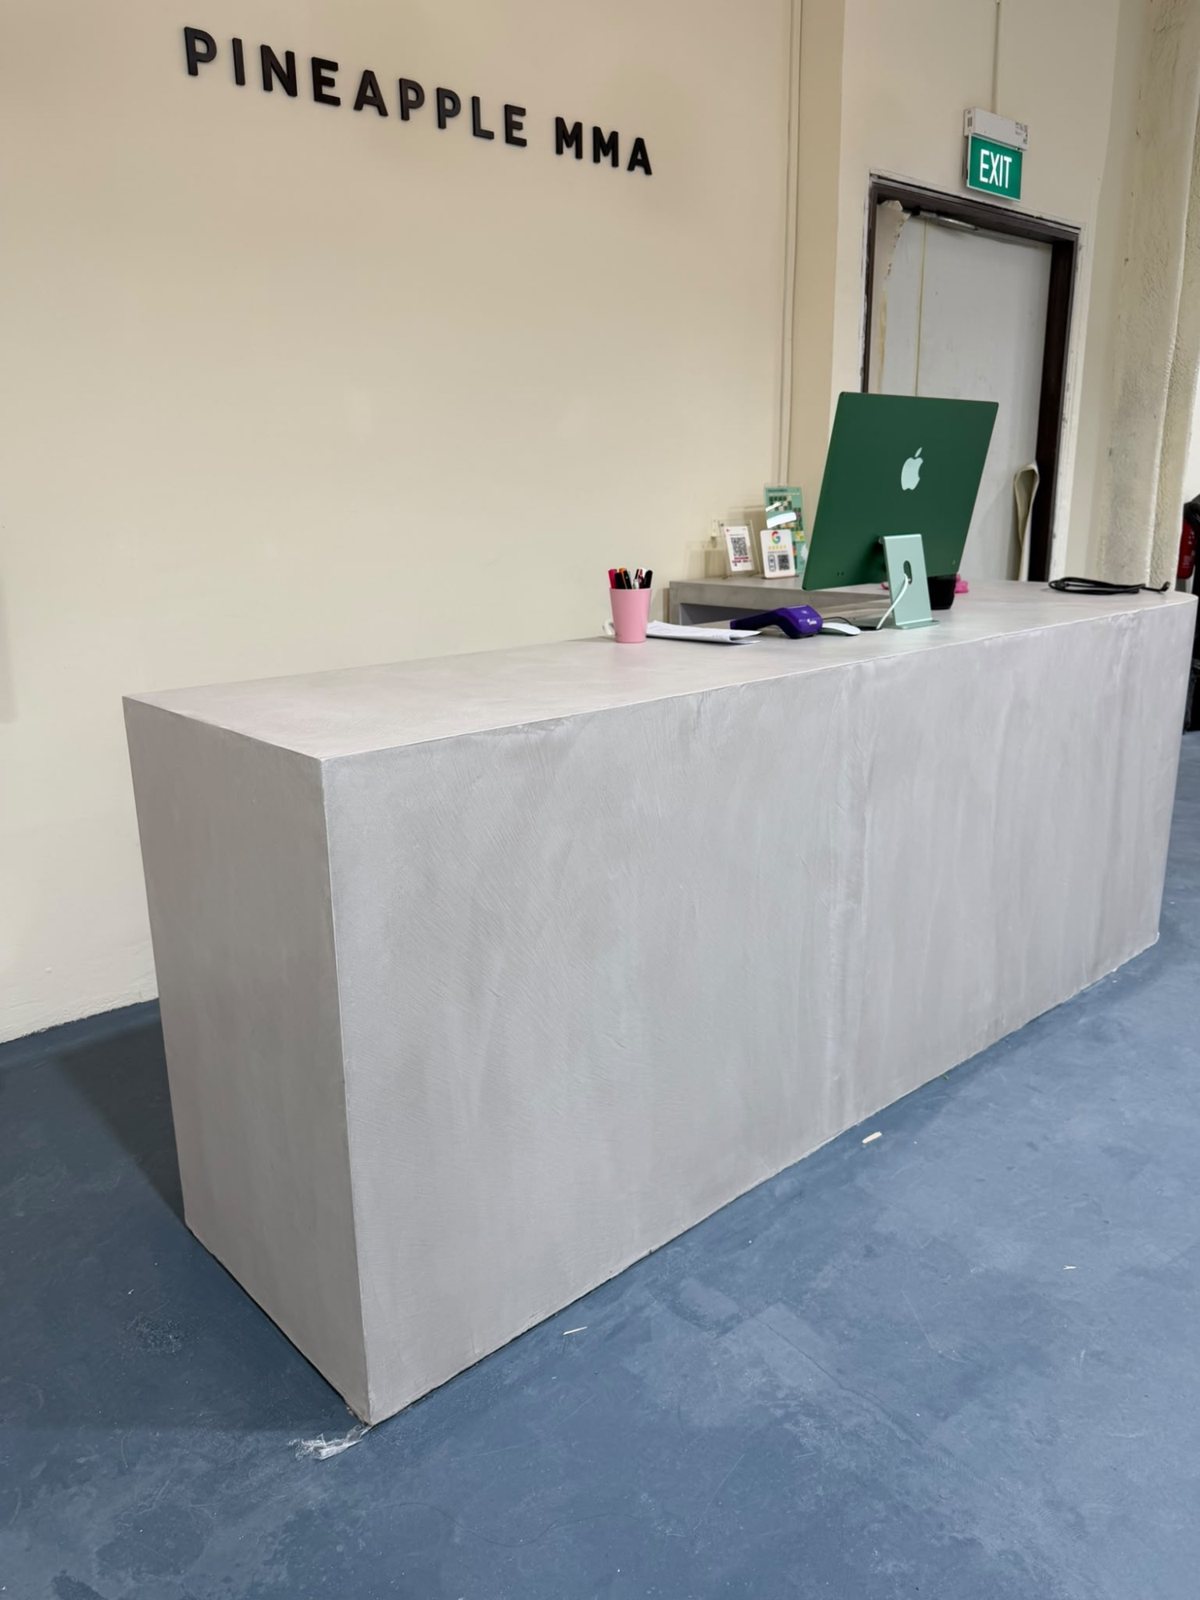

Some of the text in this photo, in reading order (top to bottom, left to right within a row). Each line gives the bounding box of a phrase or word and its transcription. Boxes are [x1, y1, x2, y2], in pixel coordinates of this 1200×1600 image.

[184, 26, 653, 176] PINEAPPLE MMA
[979, 148, 1013, 189] EXIT
